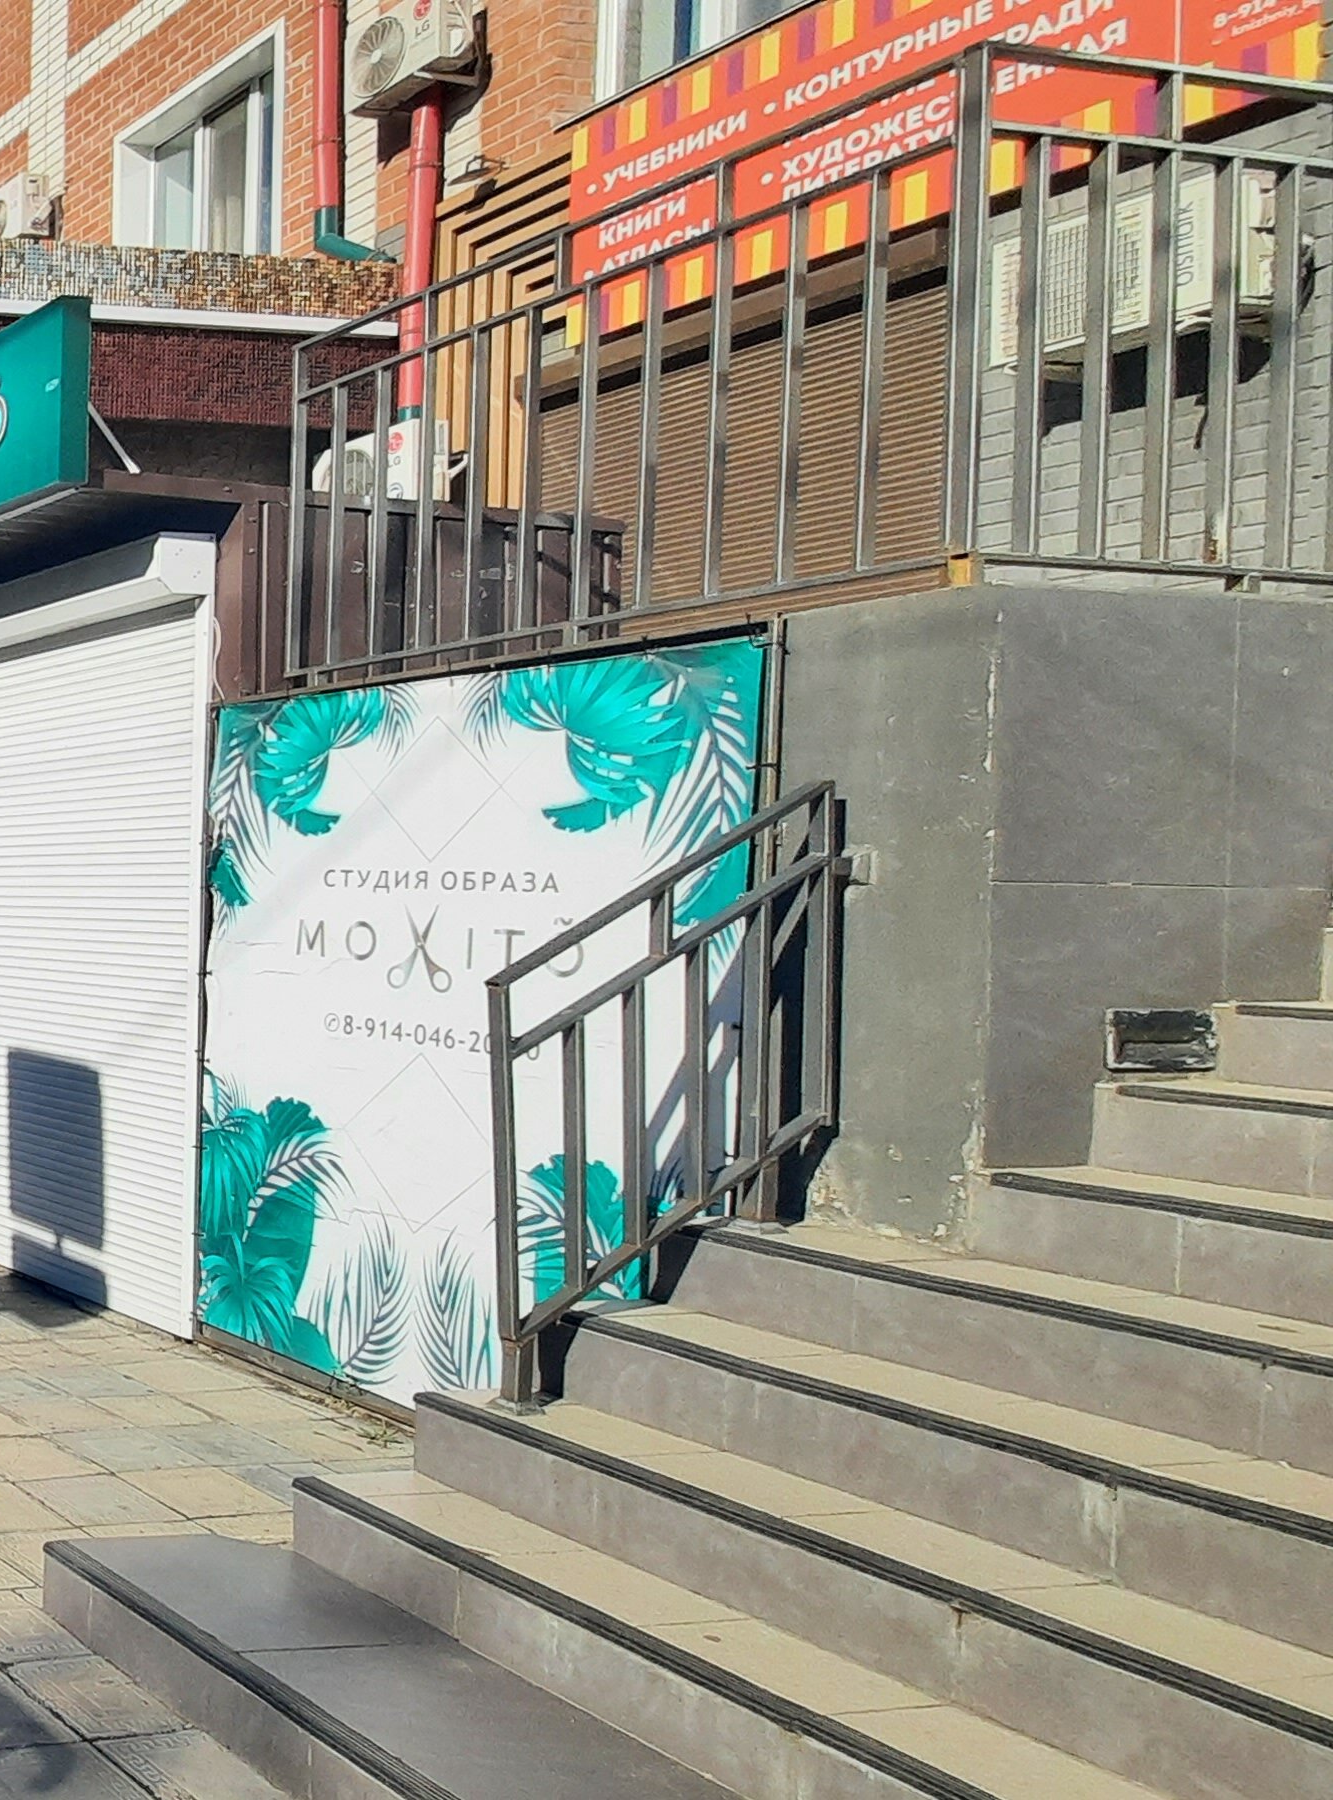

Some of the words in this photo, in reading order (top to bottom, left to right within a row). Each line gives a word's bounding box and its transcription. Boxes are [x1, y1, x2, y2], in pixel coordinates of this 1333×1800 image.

[415, 19, 431, 37] LG
[784, 0, 995, 112] КОНТУРНЫЕ
[602, 109, 748, 193] УЧЕБНИКИ
[598, 196, 686, 249] КНИГИ
[323, 869, 429, 893] СТУДИЯ
[440, 870, 560, 893] ОБРАЗА
